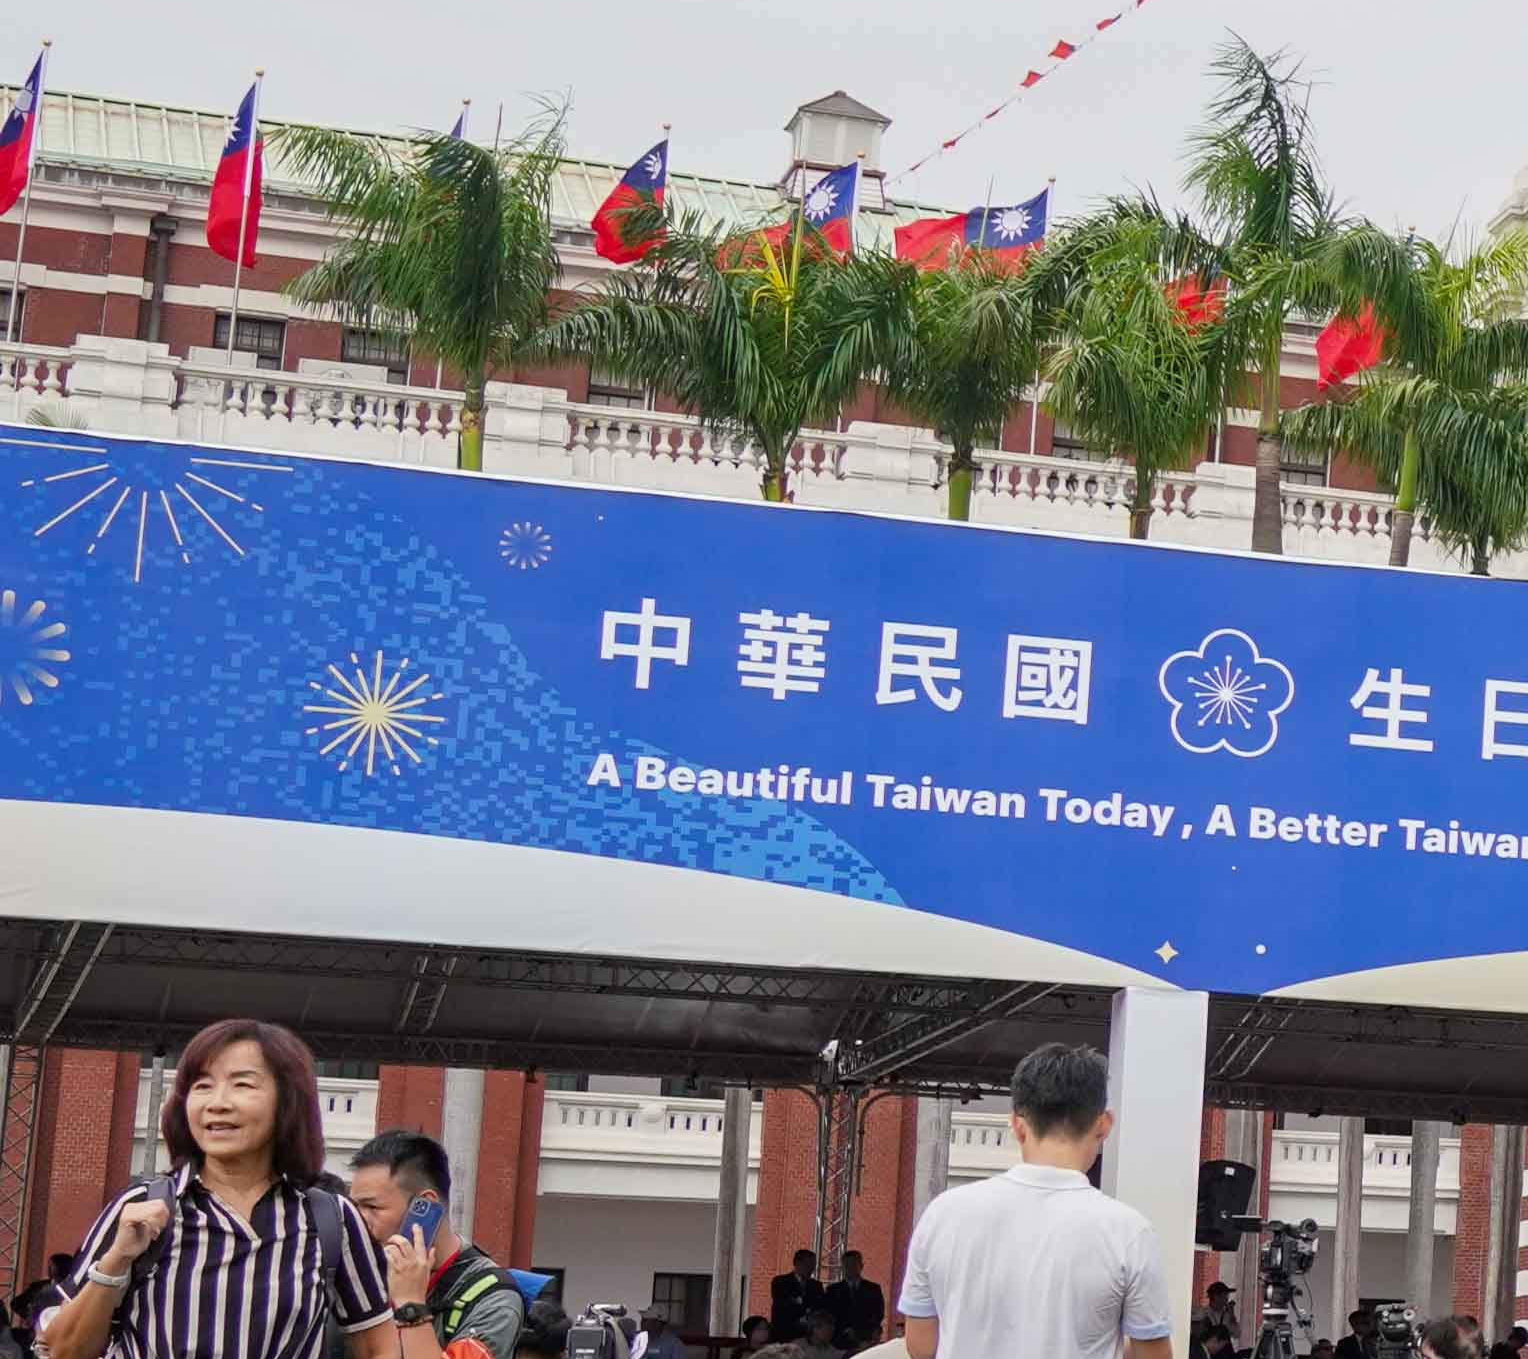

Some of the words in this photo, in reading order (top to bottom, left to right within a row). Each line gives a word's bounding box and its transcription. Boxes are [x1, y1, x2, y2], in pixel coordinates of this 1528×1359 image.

[601, 598, 1092, 724] 中華民國
[587, 753, 620, 786] A
[636, 756, 852, 805] Beautiful
[866, 774, 1025, 819] Taiwan
[1205, 804, 1236, 837] A
[1249, 807, 1387, 848] Better
